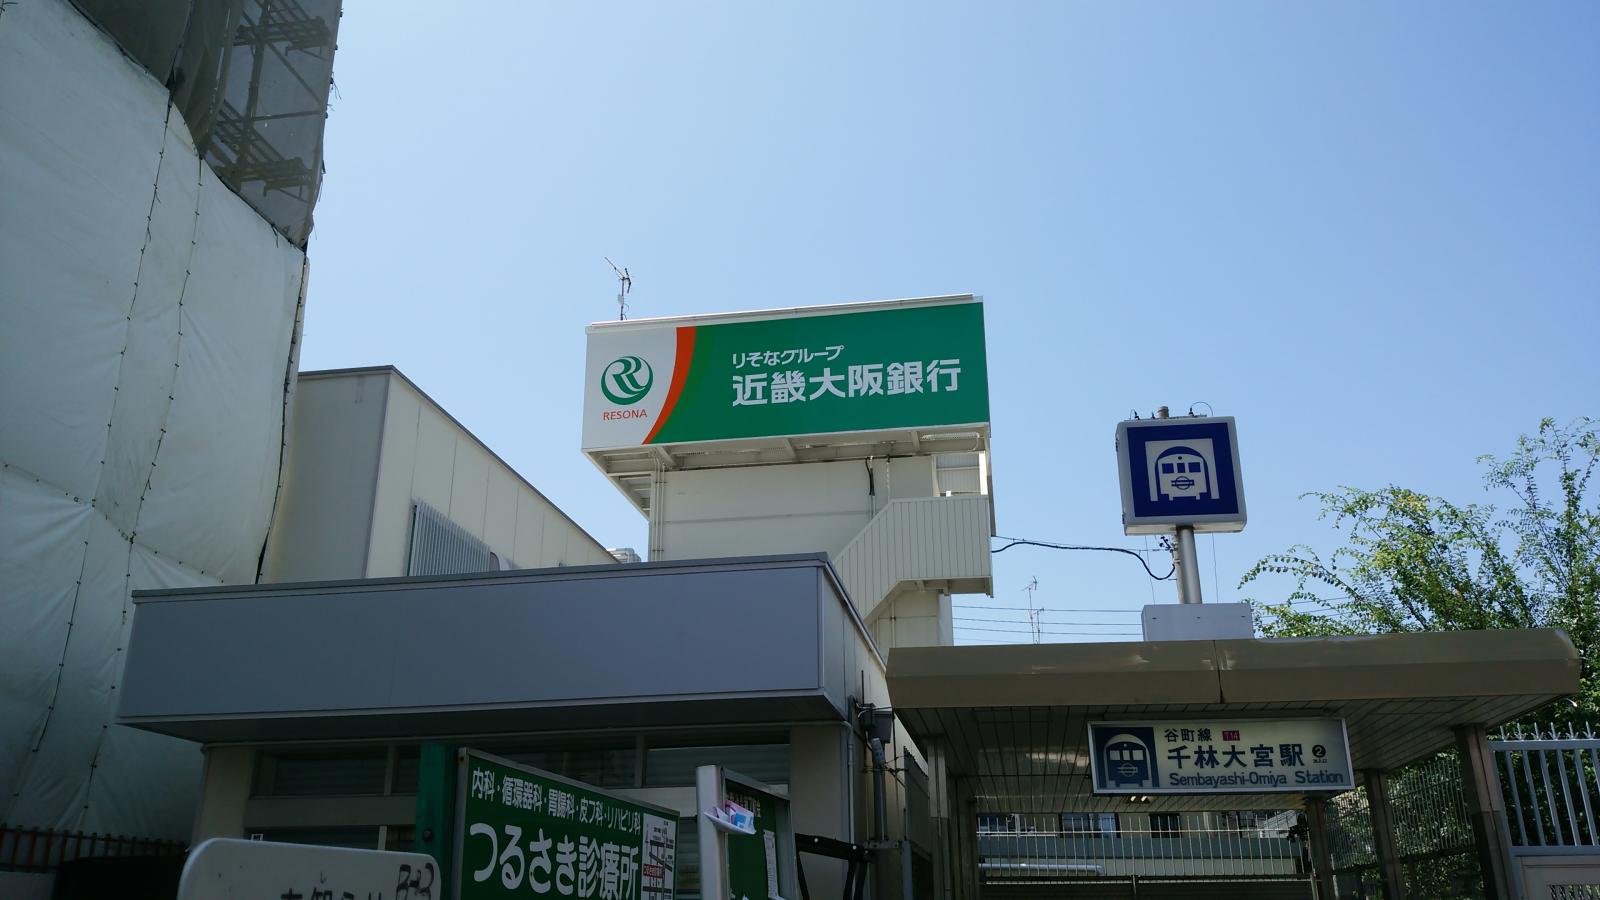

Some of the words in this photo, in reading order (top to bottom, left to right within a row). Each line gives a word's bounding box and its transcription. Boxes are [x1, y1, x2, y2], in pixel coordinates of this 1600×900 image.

[733, 345, 845, 368] りそなグループ
[732, 359, 960, 407] 近畿大阪銀行
[603, 410, 648, 421] RESONA
[1164, 728, 1212, 742] 谷町線
[1167, 743, 1304, 768] 千林大宮駅
[1169, 771, 1287, 788] Sembayashi-Omiya
[1295, 769, 1343, 783] Station
[469, 822, 639, 900] つるさき診療所
